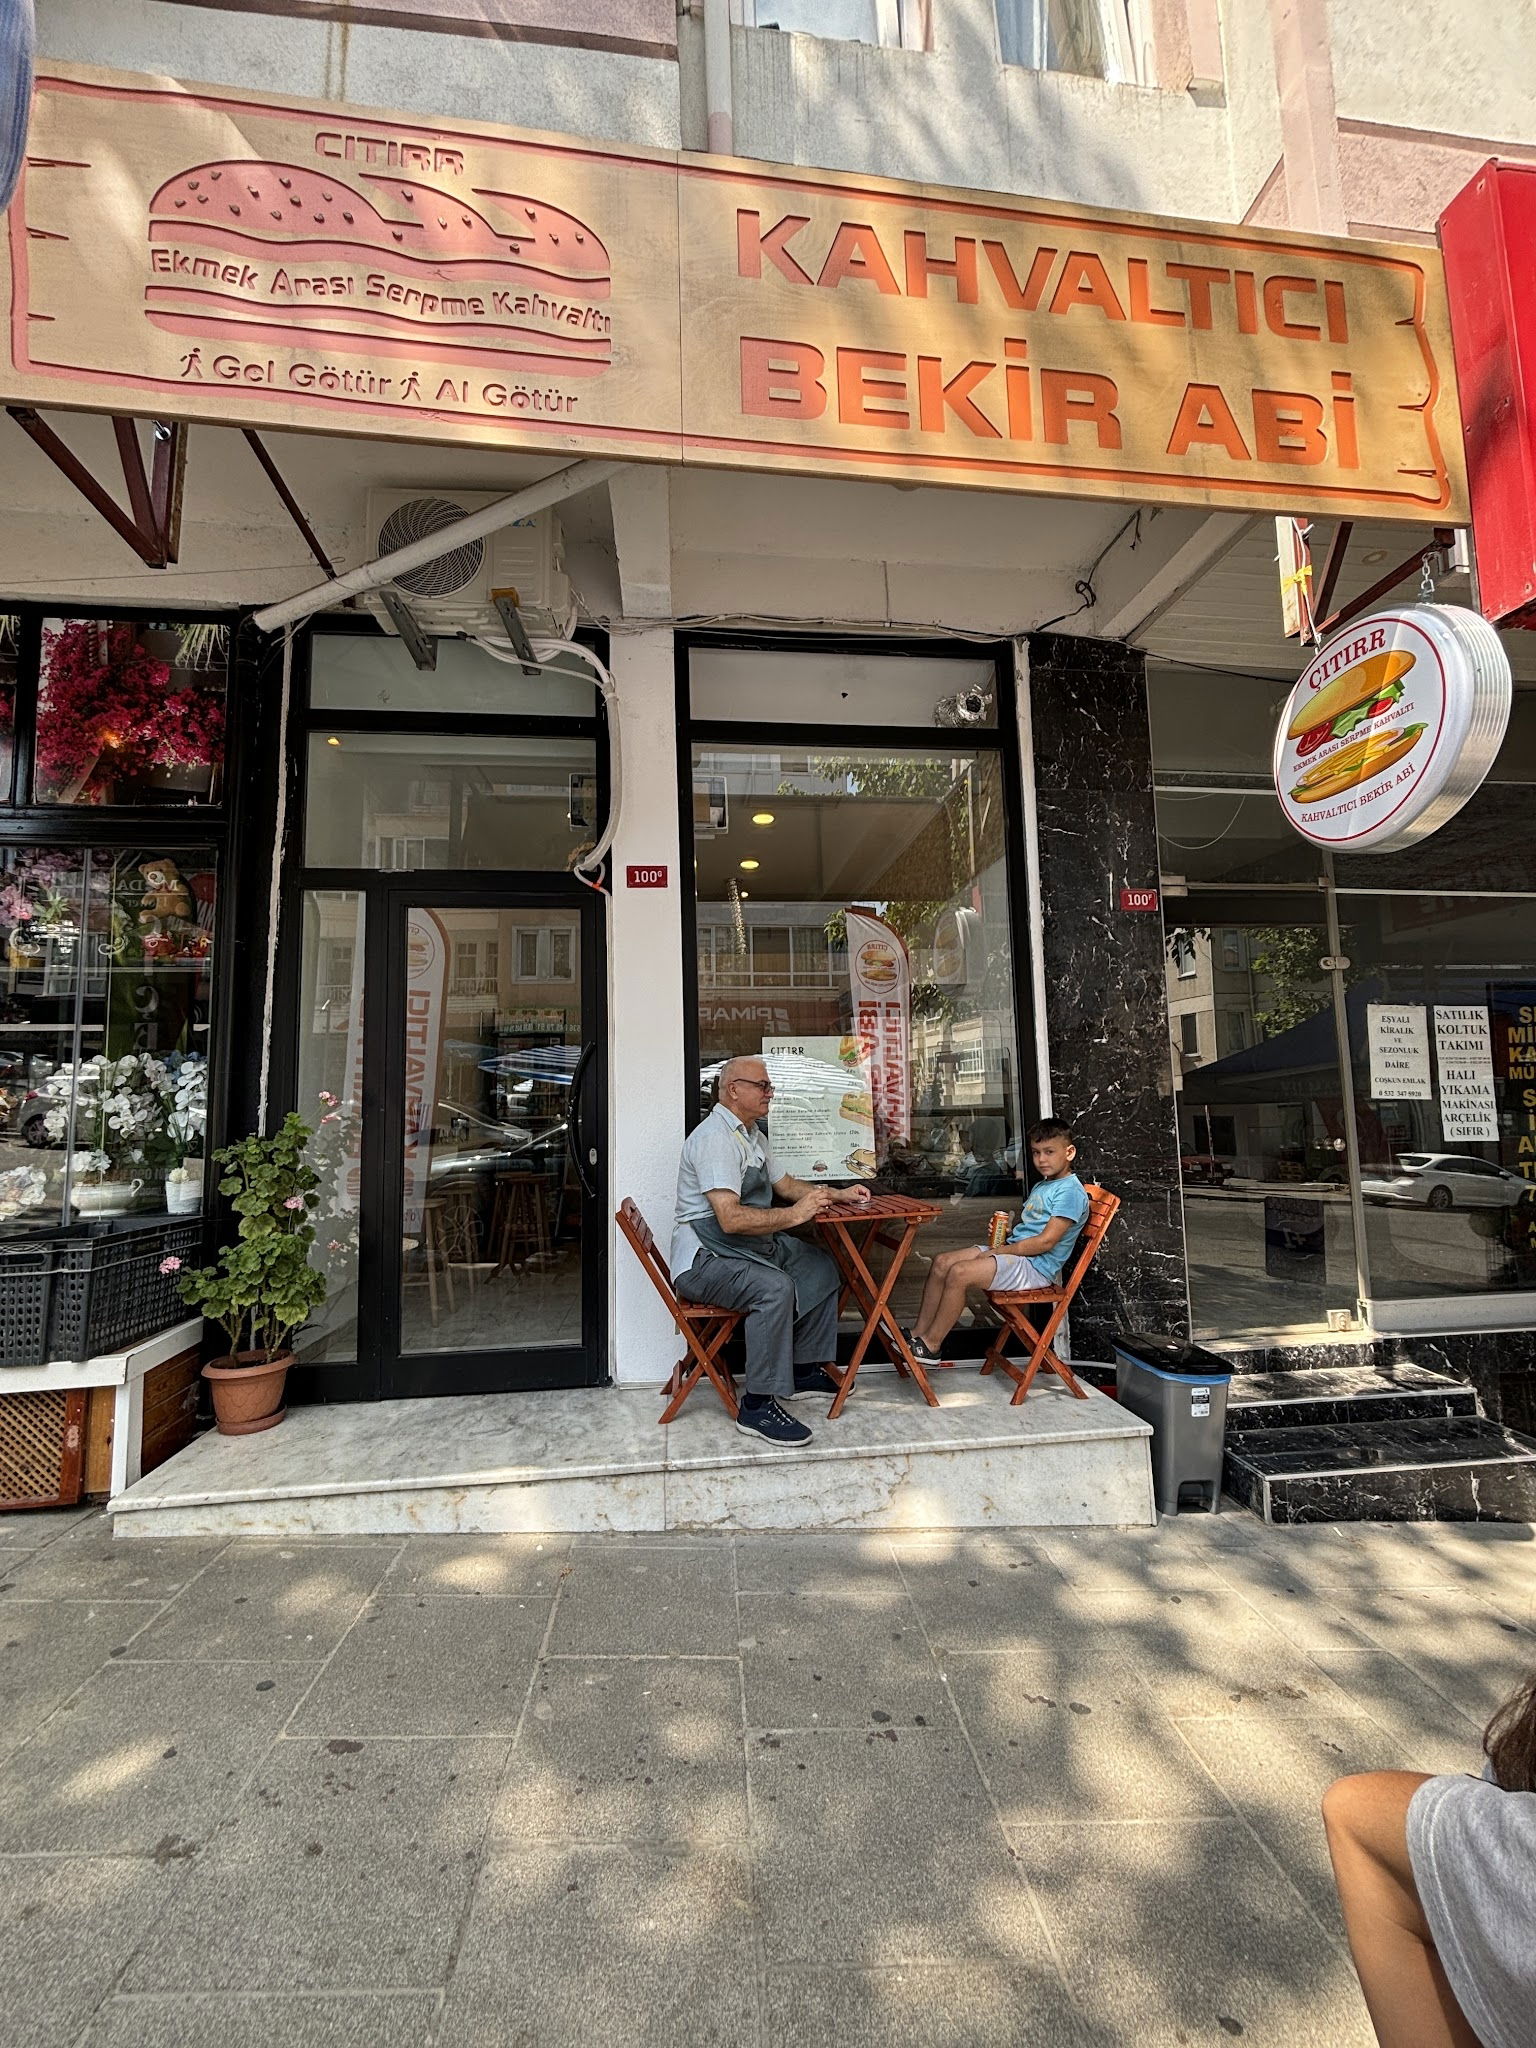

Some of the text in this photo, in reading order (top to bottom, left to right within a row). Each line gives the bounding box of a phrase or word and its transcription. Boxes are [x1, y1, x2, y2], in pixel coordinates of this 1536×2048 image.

[736, 207, 1349, 345] KAHVALTICI
[150, 247, 612, 335] Ekmek Arası Serpme Kahvaltı
[212, 352, 579, 415] Gel Götür Al Götür
[739, 335, 1360, 470] BEKİR ABİ
[1309, 627, 1387, 693] ÇITIRR
[1293, 702, 1415, 773] EKMEK ARASI SERPME KAHVALTI
[1301, 761, 1416, 823] KAHVALTICI BEKİR ABİ
[1381, 1015, 1411, 1024] EŞYALI
[1435, 1010, 1484, 1020] SATILIK
[1380, 1025, 1415, 1034] KİRALIK
[1437, 1024, 1487, 1035] KOLTUK
[1379, 1046, 1420, 1054] SEZONLUK
[1439, 1040, 1484, 1050] TAKIMI
[1385, 1061, 1410, 1069] DAİRE
[1374, 1076, 1401, 1084] COŞKUN
[1447, 1070, 1476, 1080] HALI
[1441, 1085, 1490, 1095] YIKAMA
[1442, 1099, 1494, 1109] MAKİNASI
[1444, 1112, 1492, 1124] ARÇELİK
